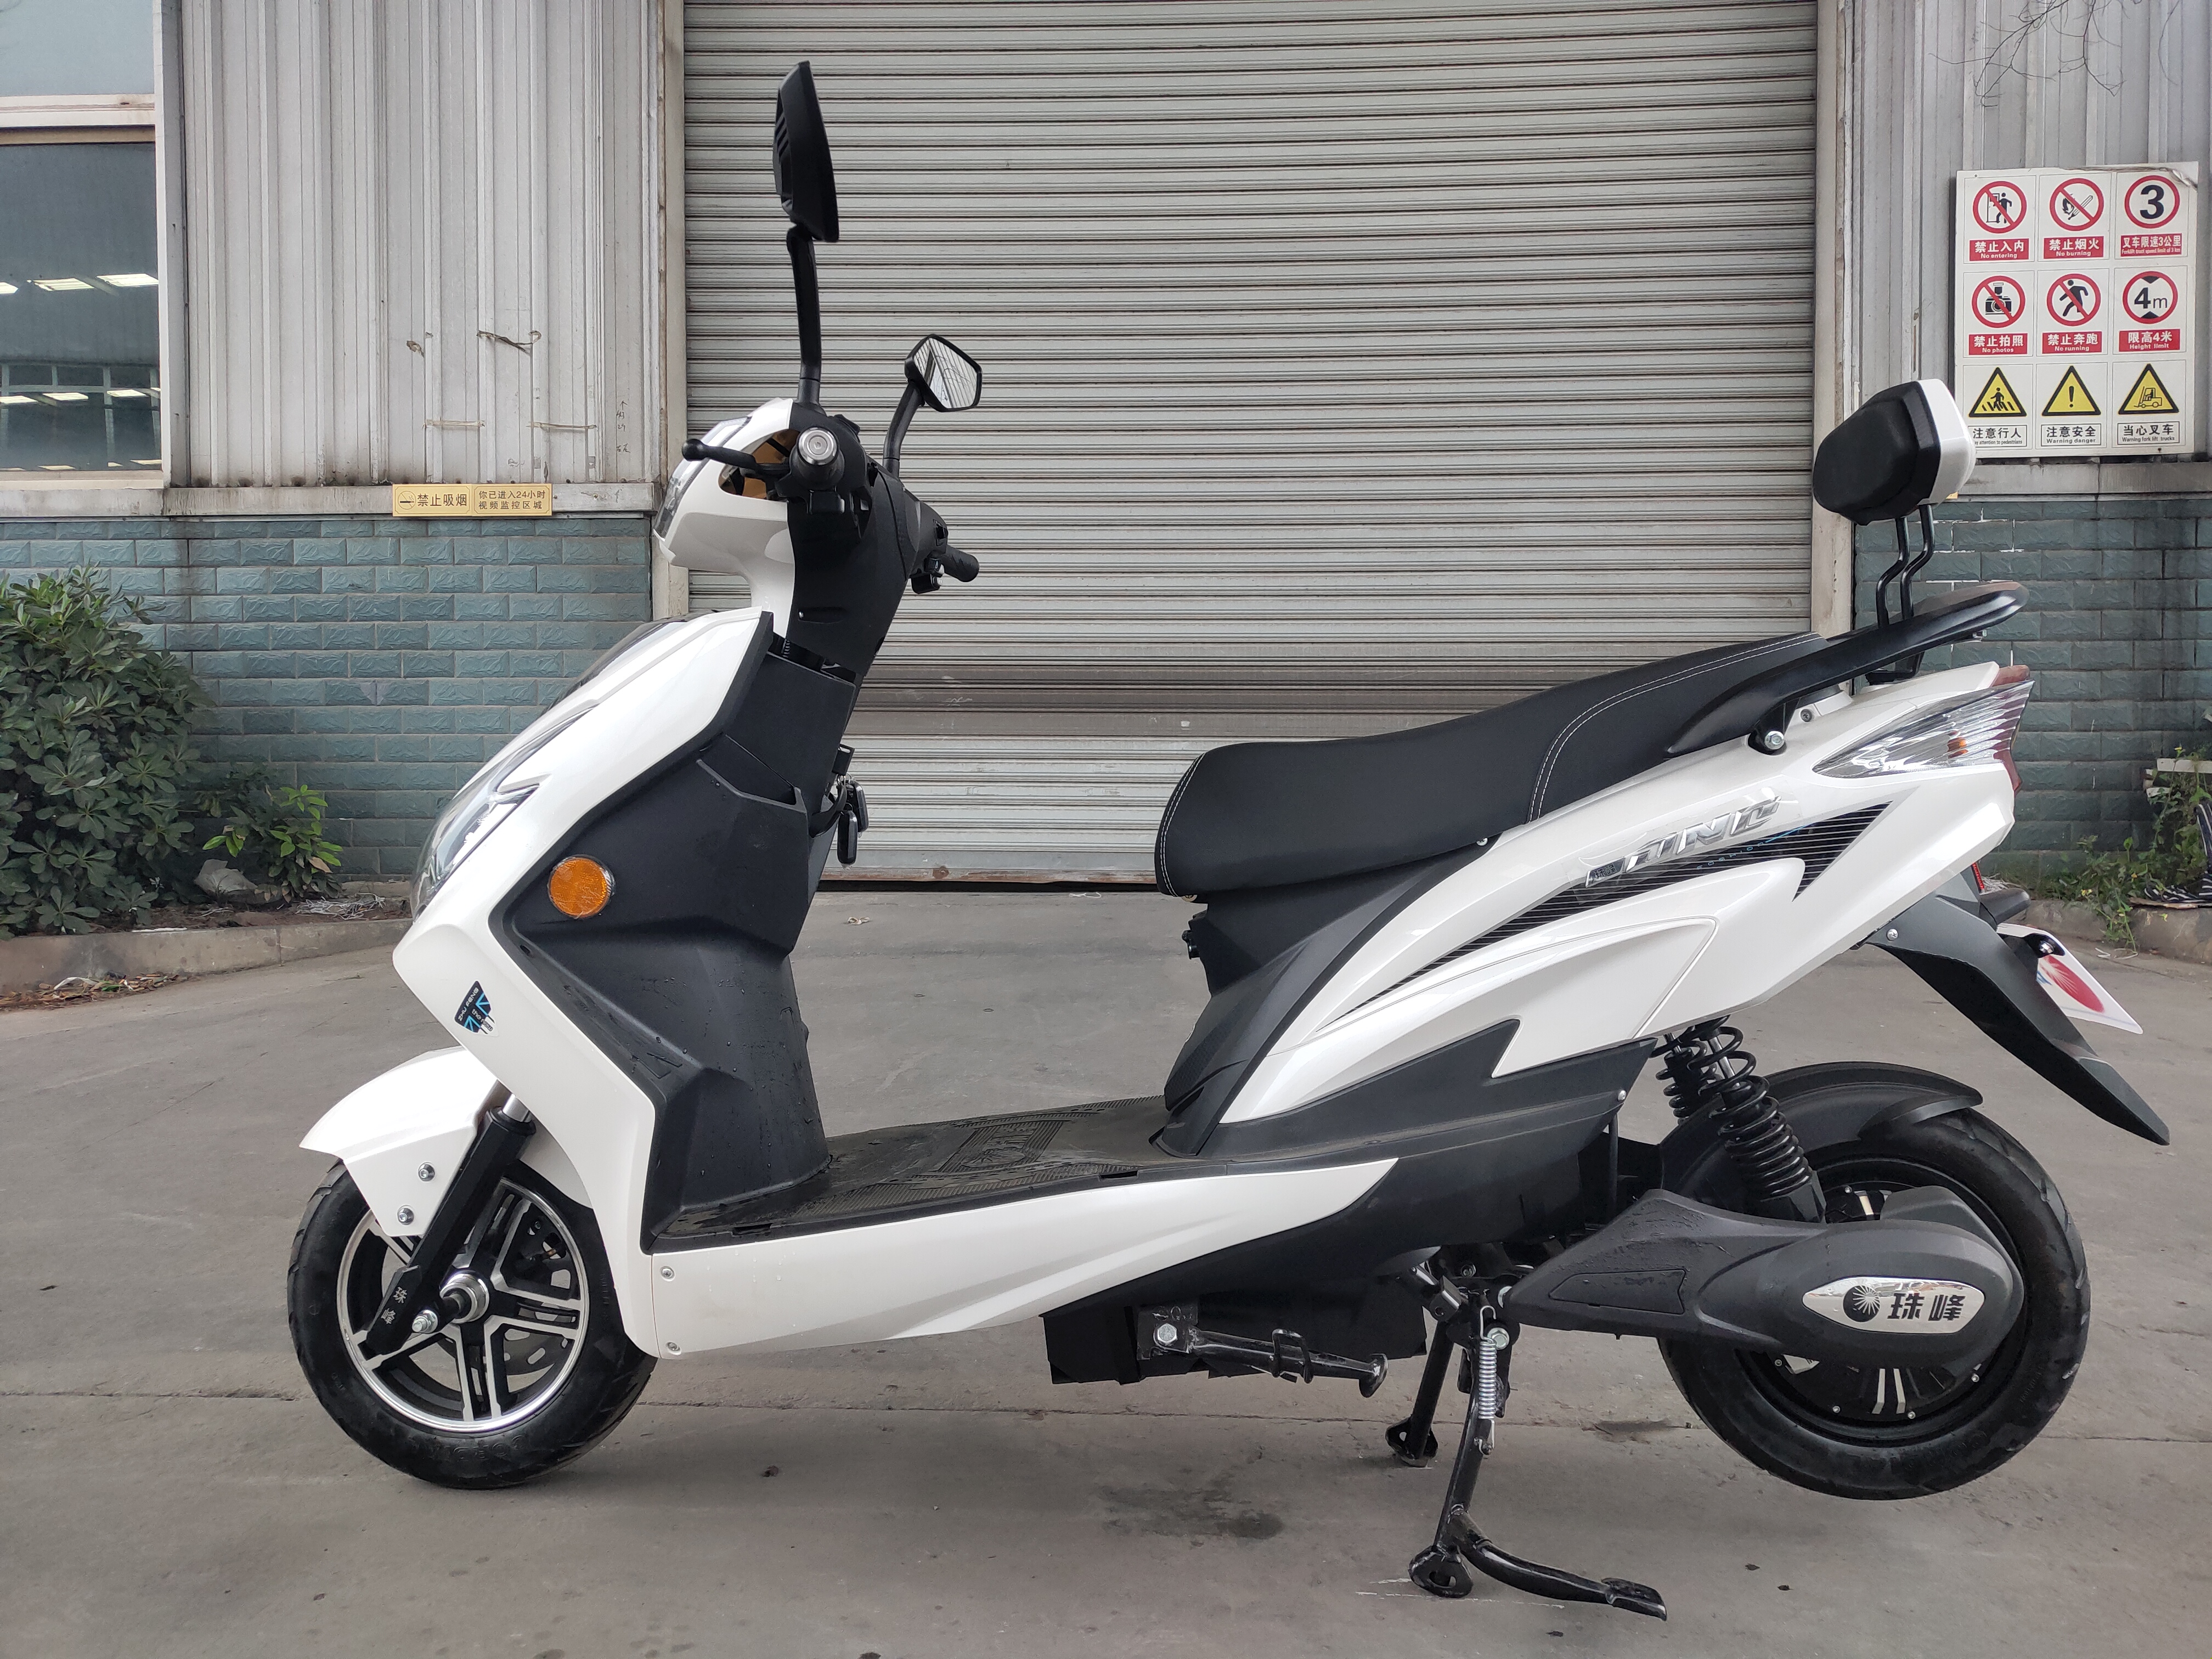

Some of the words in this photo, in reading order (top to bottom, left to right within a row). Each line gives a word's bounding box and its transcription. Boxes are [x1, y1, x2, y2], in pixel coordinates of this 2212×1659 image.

[2140, 184, 2165, 219] 3
[1975, 240, 2024, 253] 禁止入内
[2049, 238, 2100, 251] 禁止烟火
[2123, 235, 2181, 248] 叉车限速3公里
[1974, 335, 2023, 347] 禁止拍照
[2047, 333, 2098, 346] 禁止奔跑
[2128, 331, 2172, 343] 限高4米
[1973, 427, 2021, 439] 注意行人
[2046, 426, 2096, 437] 注意安全
[2123, 424, 2174, 436] 当心叉车
[417, 493, 467, 506] 禁止吸烟
[478, 490, 545, 499] 你已进入24小时
[380, 1286, 408, 1324] 珠峰
[1887, 1293, 1966, 1321] 珠峰
